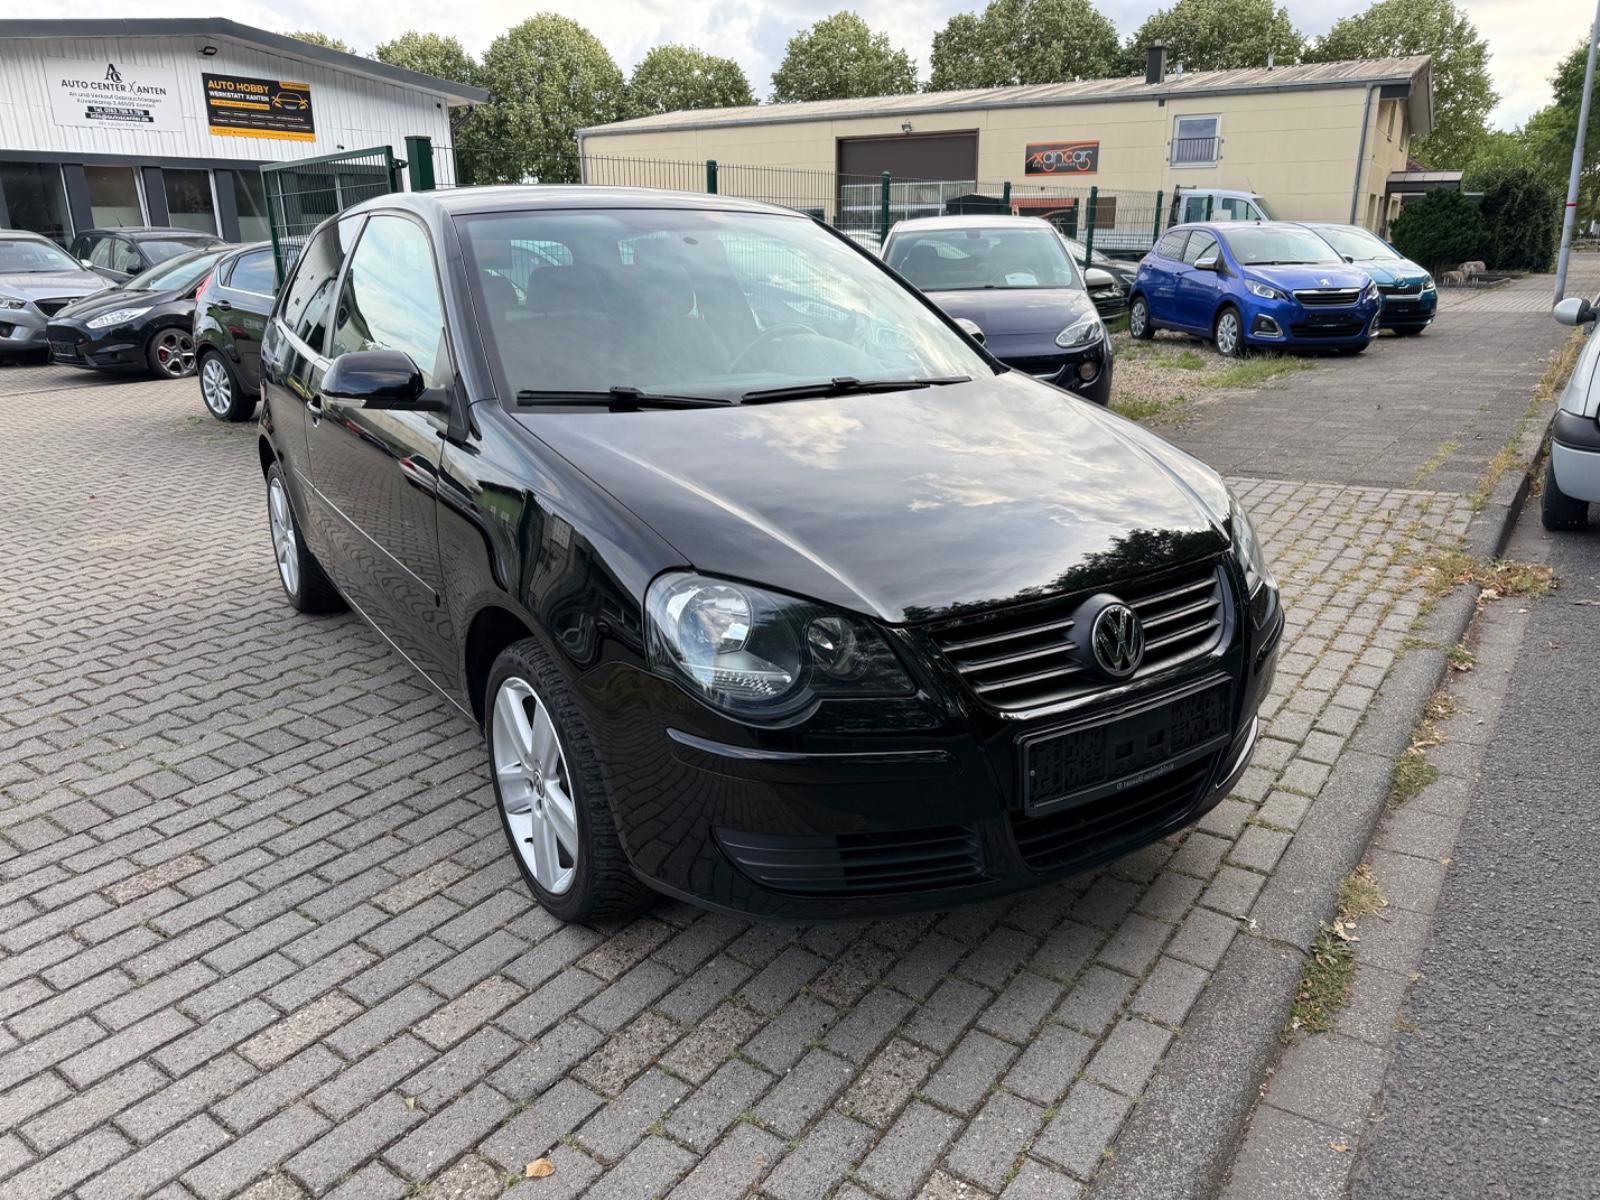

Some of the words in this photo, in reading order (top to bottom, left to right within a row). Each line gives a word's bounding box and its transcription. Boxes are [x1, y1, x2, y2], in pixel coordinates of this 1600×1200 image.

[61, 79, 88, 89] AUTO
[90, 82, 126, 92] CENTER
[128, 81, 167, 95] XANTEN
[207, 80, 235, 90] AUTO
[236, 83, 269, 94] HOBBY
[208, 91, 245, 100] WERKSTATT
[246, 94, 270, 102] XANTEN
